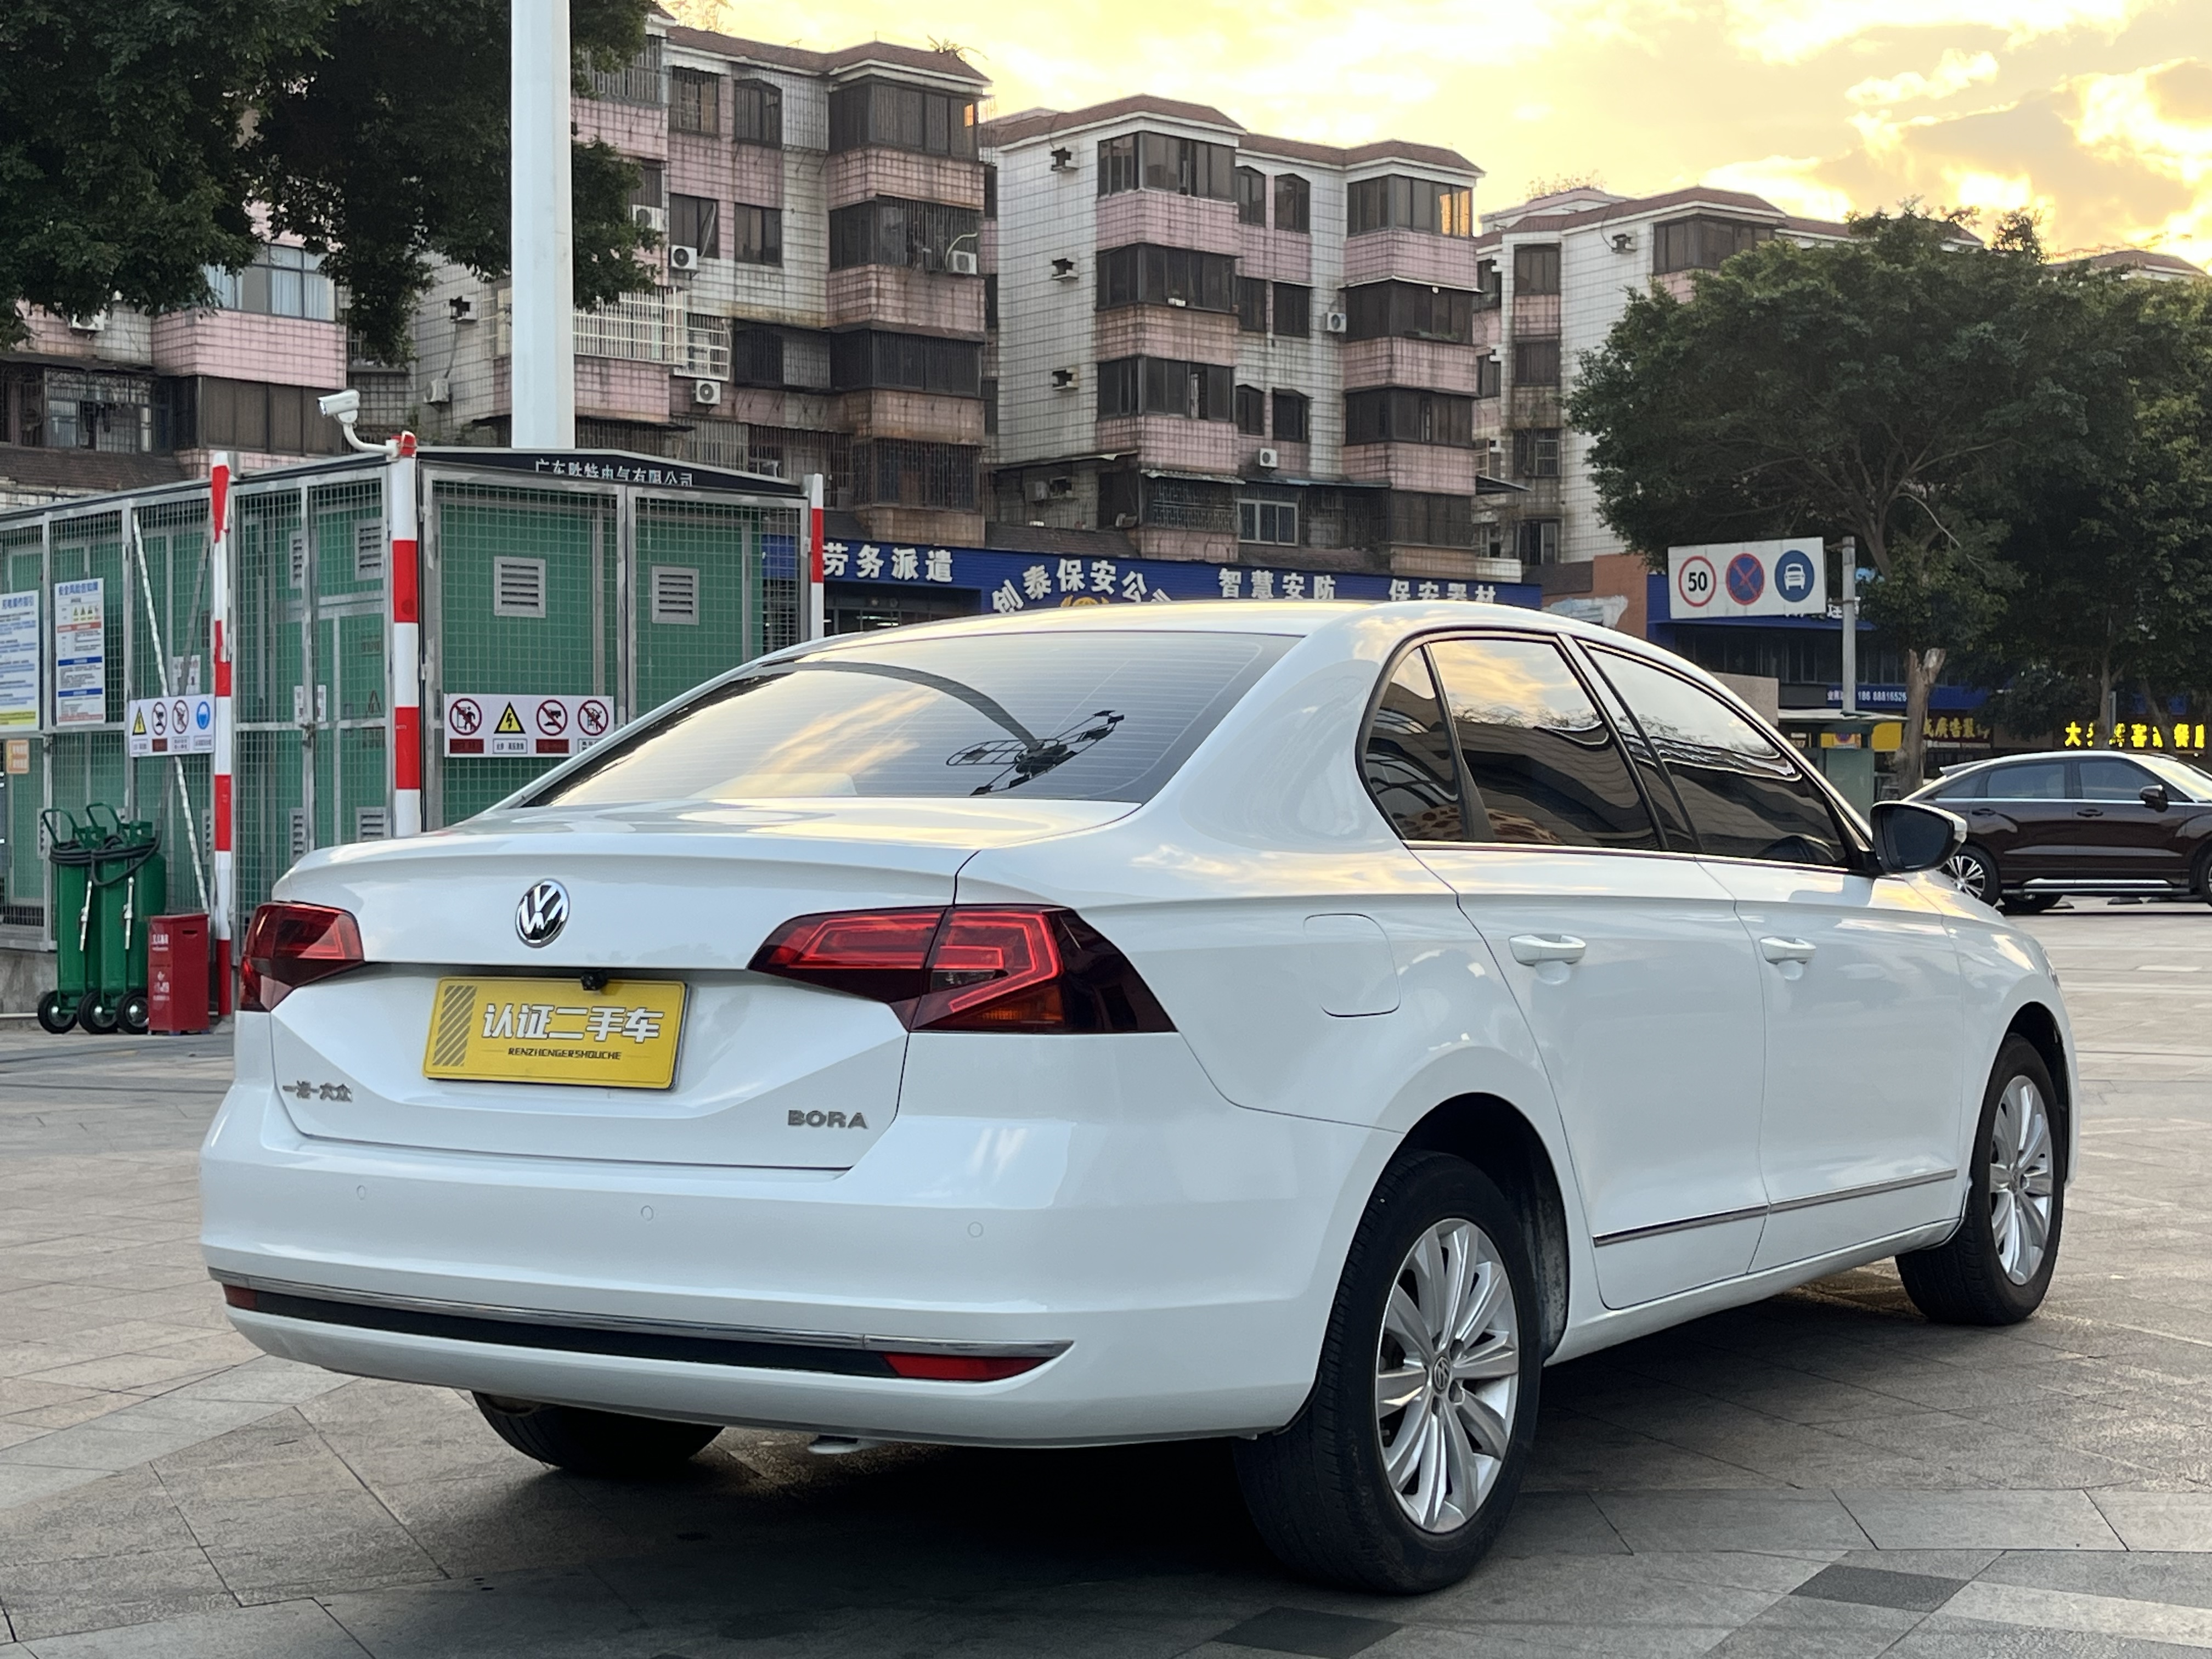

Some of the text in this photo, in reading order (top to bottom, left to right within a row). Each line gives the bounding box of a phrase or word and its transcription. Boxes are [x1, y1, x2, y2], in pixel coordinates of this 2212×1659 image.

[822, 542, 953, 582] 劳务派遣
[1219, 568, 1336, 600] 智慧安防
[1688, 571, 1707, 591] 50
[482, 1003, 665, 1043] 认证二手车
[508, 1047, 622, 1060] RENZHENGERSHOUCHE
[788, 1109, 868, 1130] BORA
